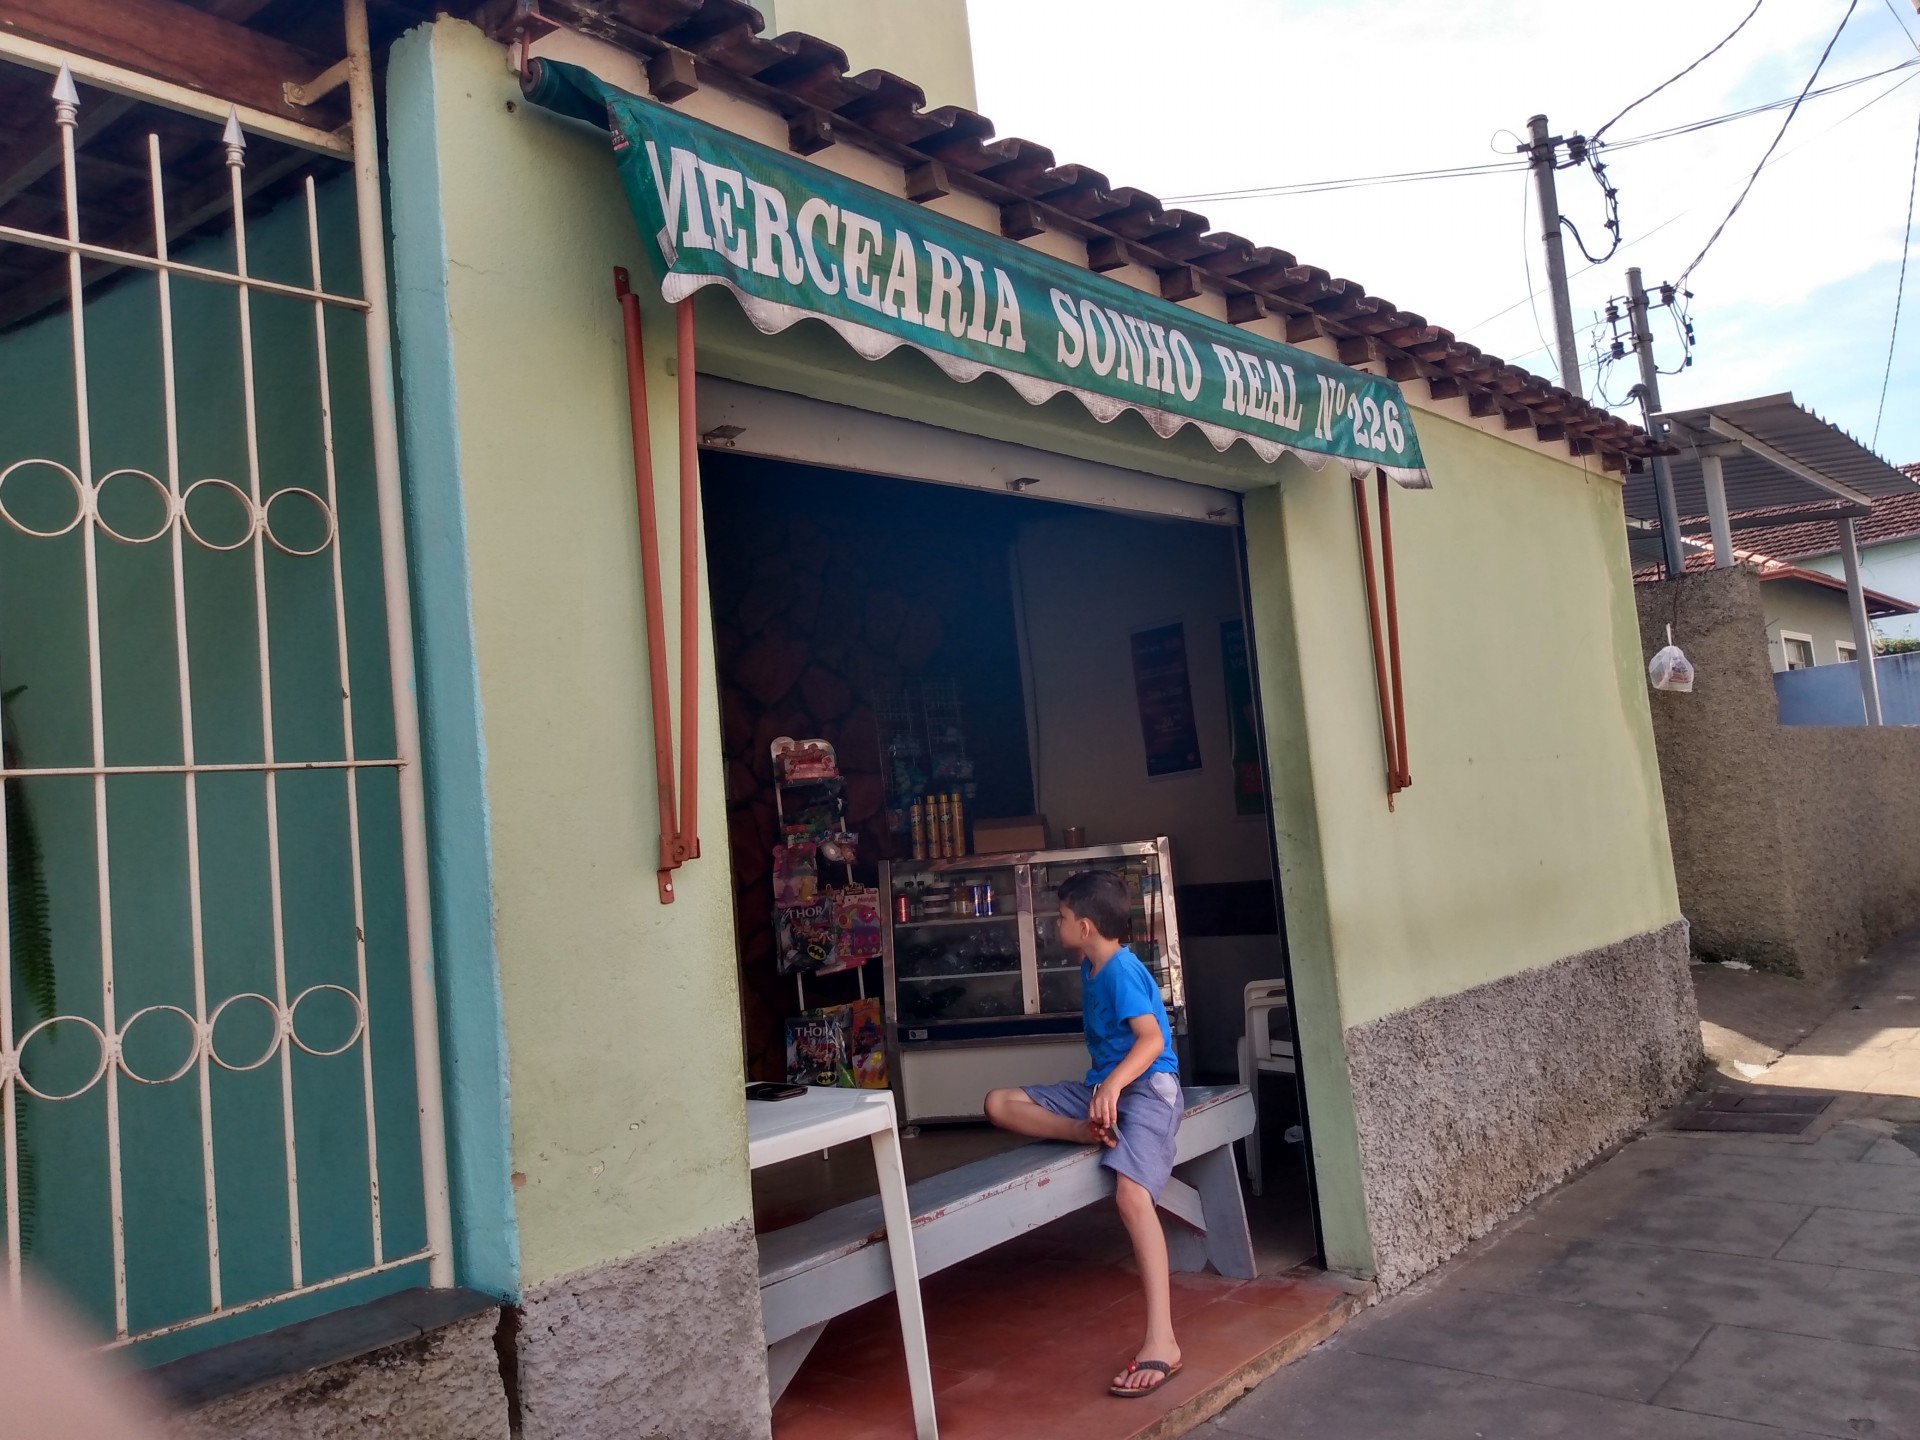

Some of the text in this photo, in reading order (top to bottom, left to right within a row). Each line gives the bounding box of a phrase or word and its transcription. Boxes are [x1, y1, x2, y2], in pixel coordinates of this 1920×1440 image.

[646, 140, 1026, 354] MERCEARIA
[1050, 287, 1202, 402] SONHO
[1212, 343, 1303, 432] REAL
[1347, 392, 1405, 454] 226
[788, 906, 823, 919] THOR
